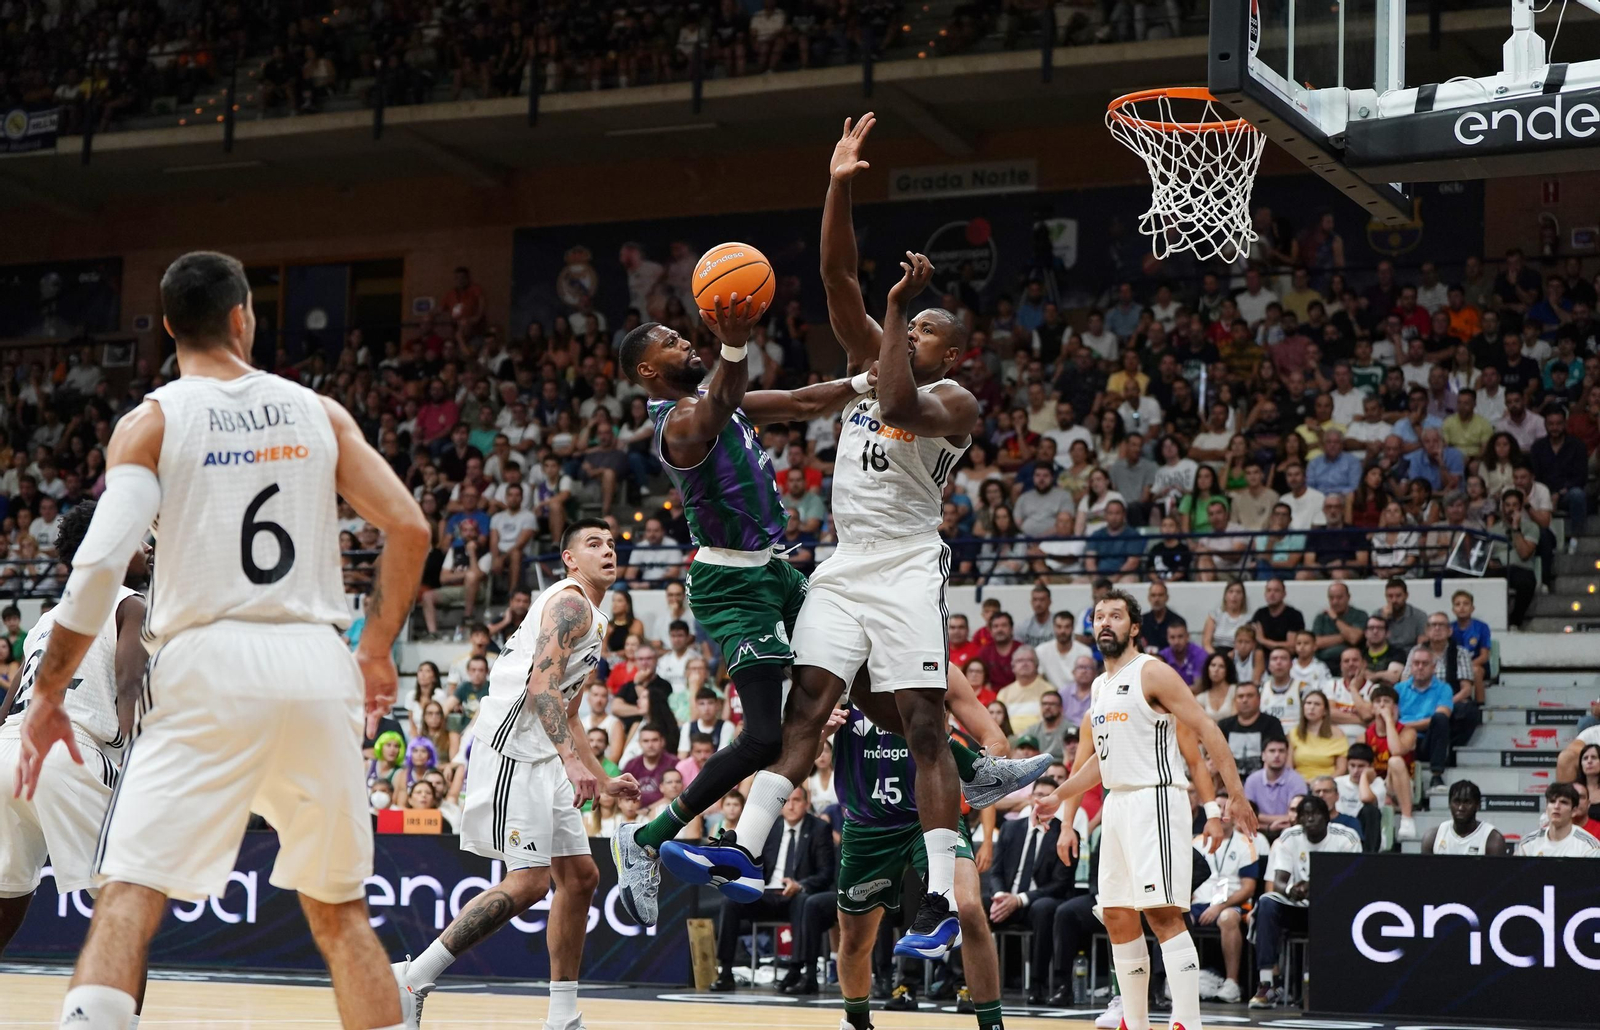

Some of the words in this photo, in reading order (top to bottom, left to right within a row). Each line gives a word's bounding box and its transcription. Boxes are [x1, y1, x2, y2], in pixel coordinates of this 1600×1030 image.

[1454, 94, 1600, 145] ende
[896, 173, 963, 191] Grada
[972, 168, 1030, 186] Norte
[711, 252, 745, 268] endesa
[207, 403, 295, 432] ABALDE
[203, 445, 309, 466] AUTOHERO
[862, 440, 890, 472] 18
[241, 482, 295, 585] 6
[871, 777, 903, 805] 45
[424, 818, 438, 826] IRS
